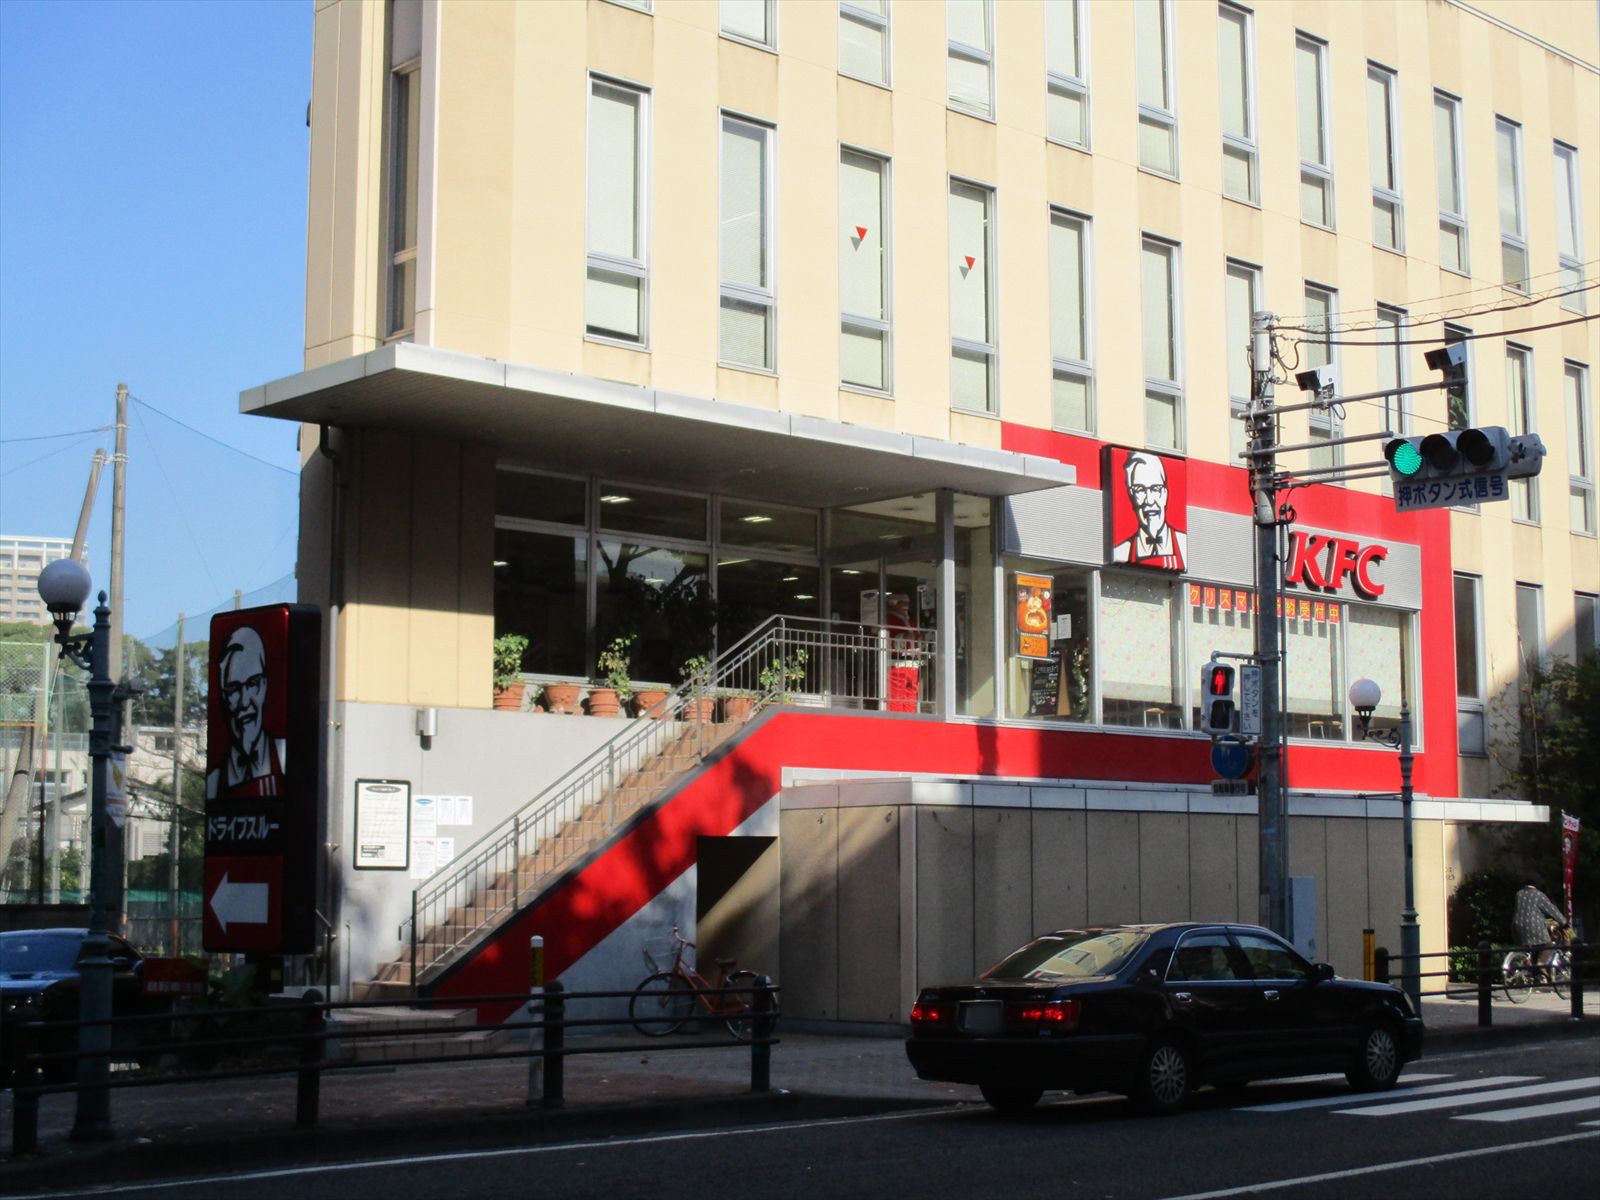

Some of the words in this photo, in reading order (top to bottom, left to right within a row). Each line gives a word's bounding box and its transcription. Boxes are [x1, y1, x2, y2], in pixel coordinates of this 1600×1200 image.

[1398, 476, 1504, 507] 押ボタン式信号
[1286, 531, 1389, 597] KFC
[207, 815, 280, 841] ドライブスルー
